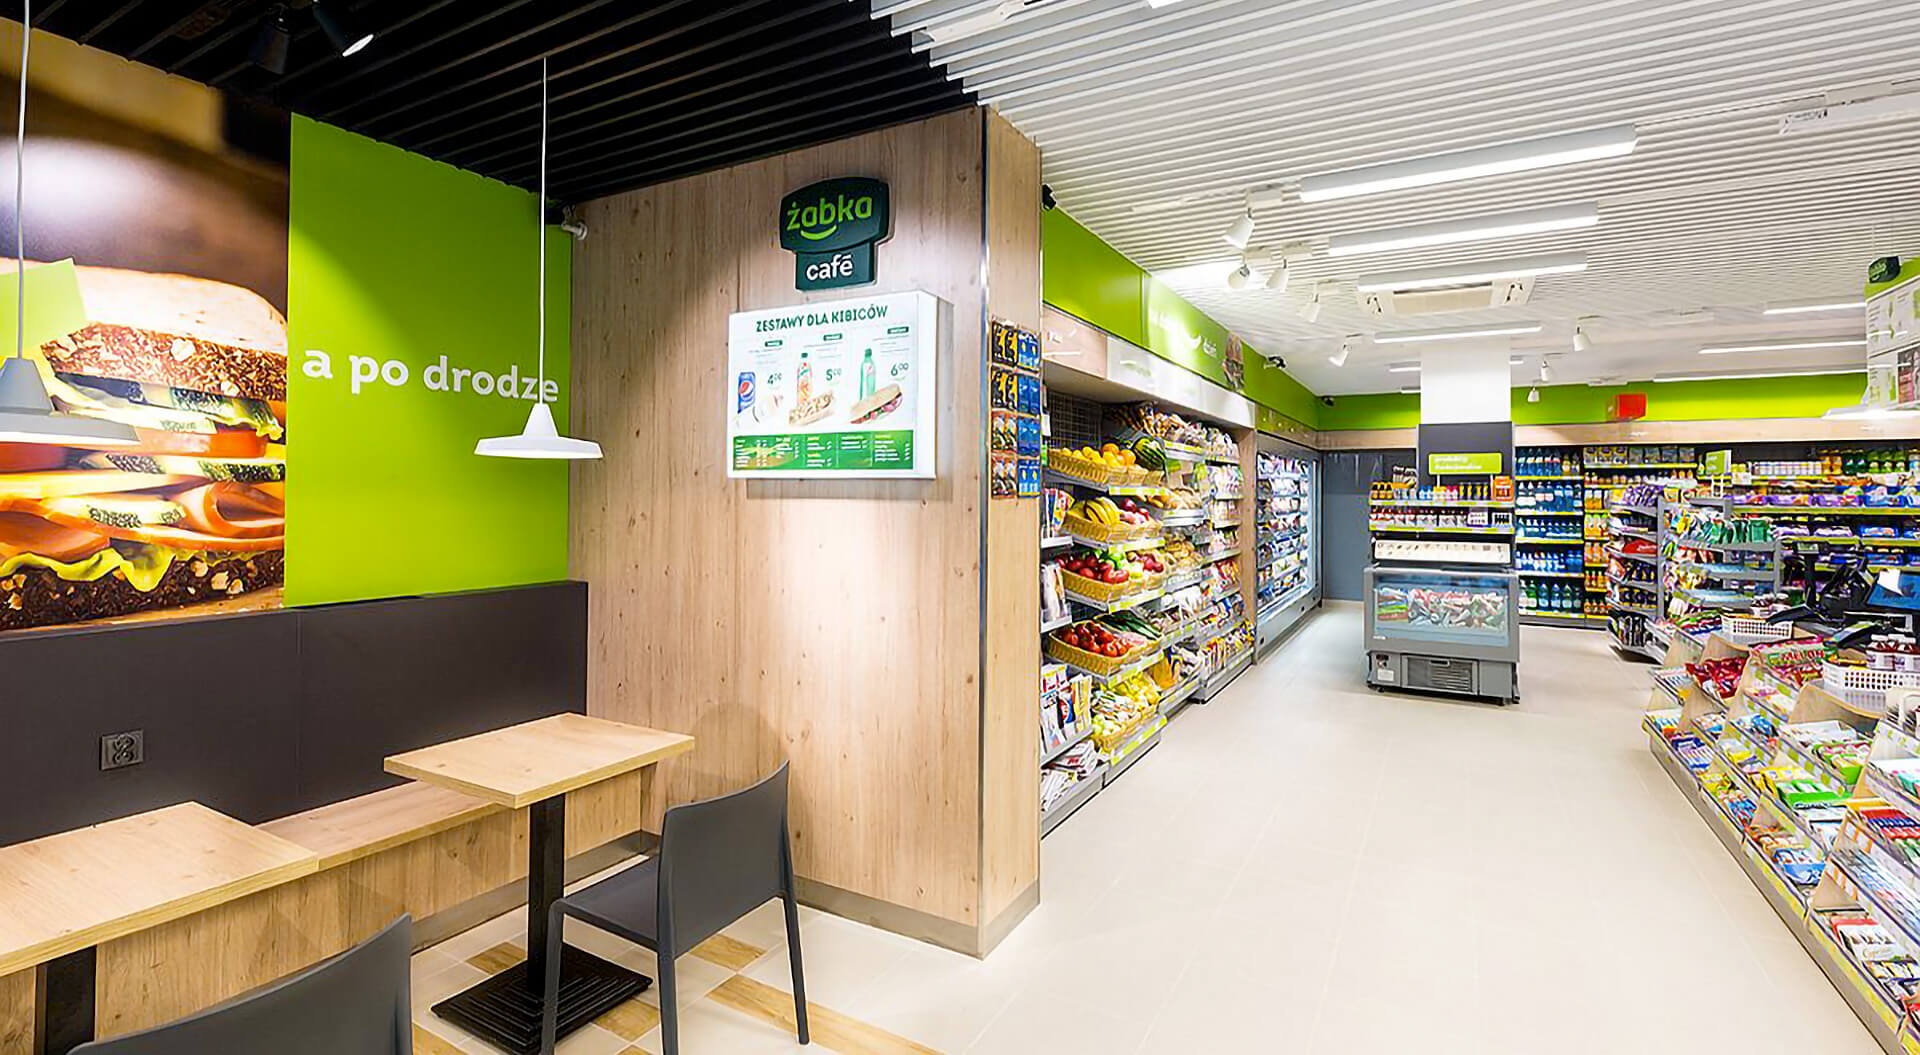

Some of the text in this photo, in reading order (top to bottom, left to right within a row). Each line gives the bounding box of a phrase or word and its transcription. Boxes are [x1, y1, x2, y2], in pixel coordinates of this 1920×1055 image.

[786, 194, 873, 231] żabka
[756, 303, 889, 332] ZESTAWY DLA KIBICÓW
[302, 349, 560, 402] a po drodze
